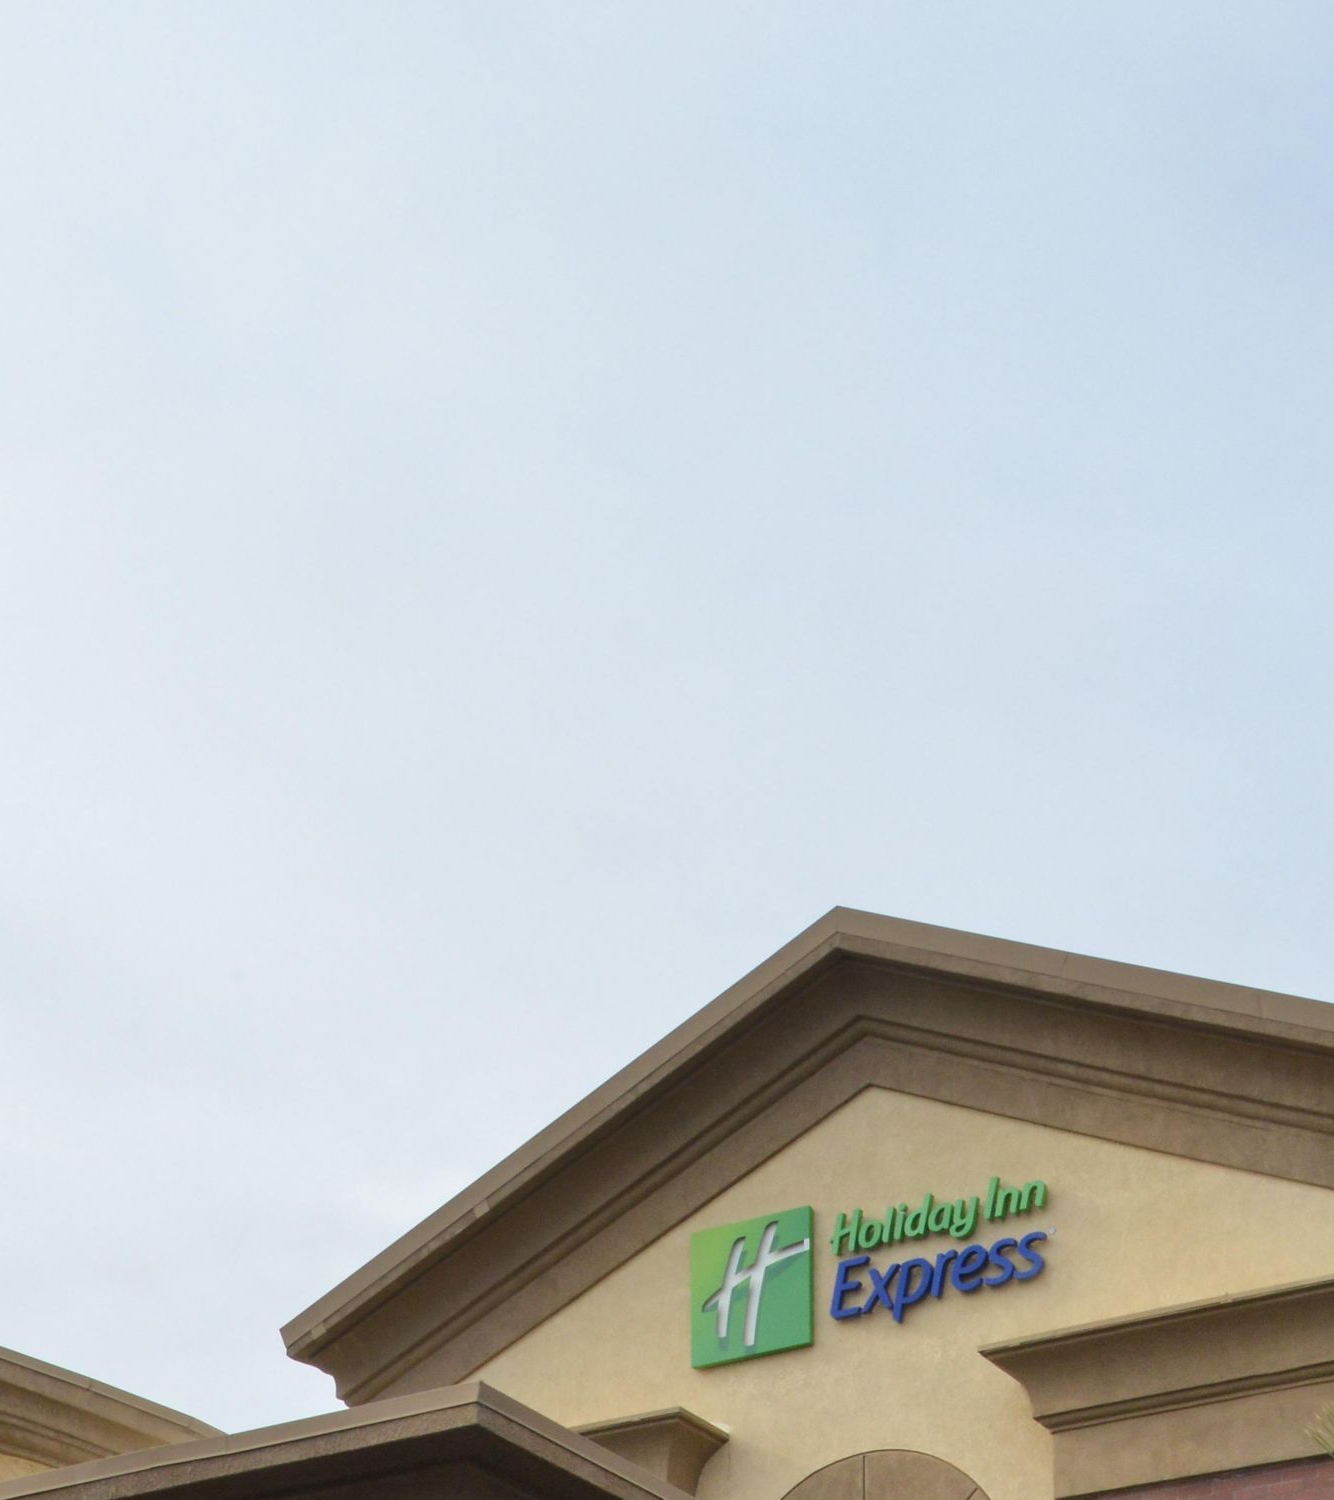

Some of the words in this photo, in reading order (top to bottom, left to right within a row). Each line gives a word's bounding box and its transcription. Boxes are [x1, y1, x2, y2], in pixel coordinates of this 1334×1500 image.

[830, 1192, 979, 1256] Holiday
[983, 1176, 1047, 1222] Inn
[829, 1231, 1048, 1324] Express
